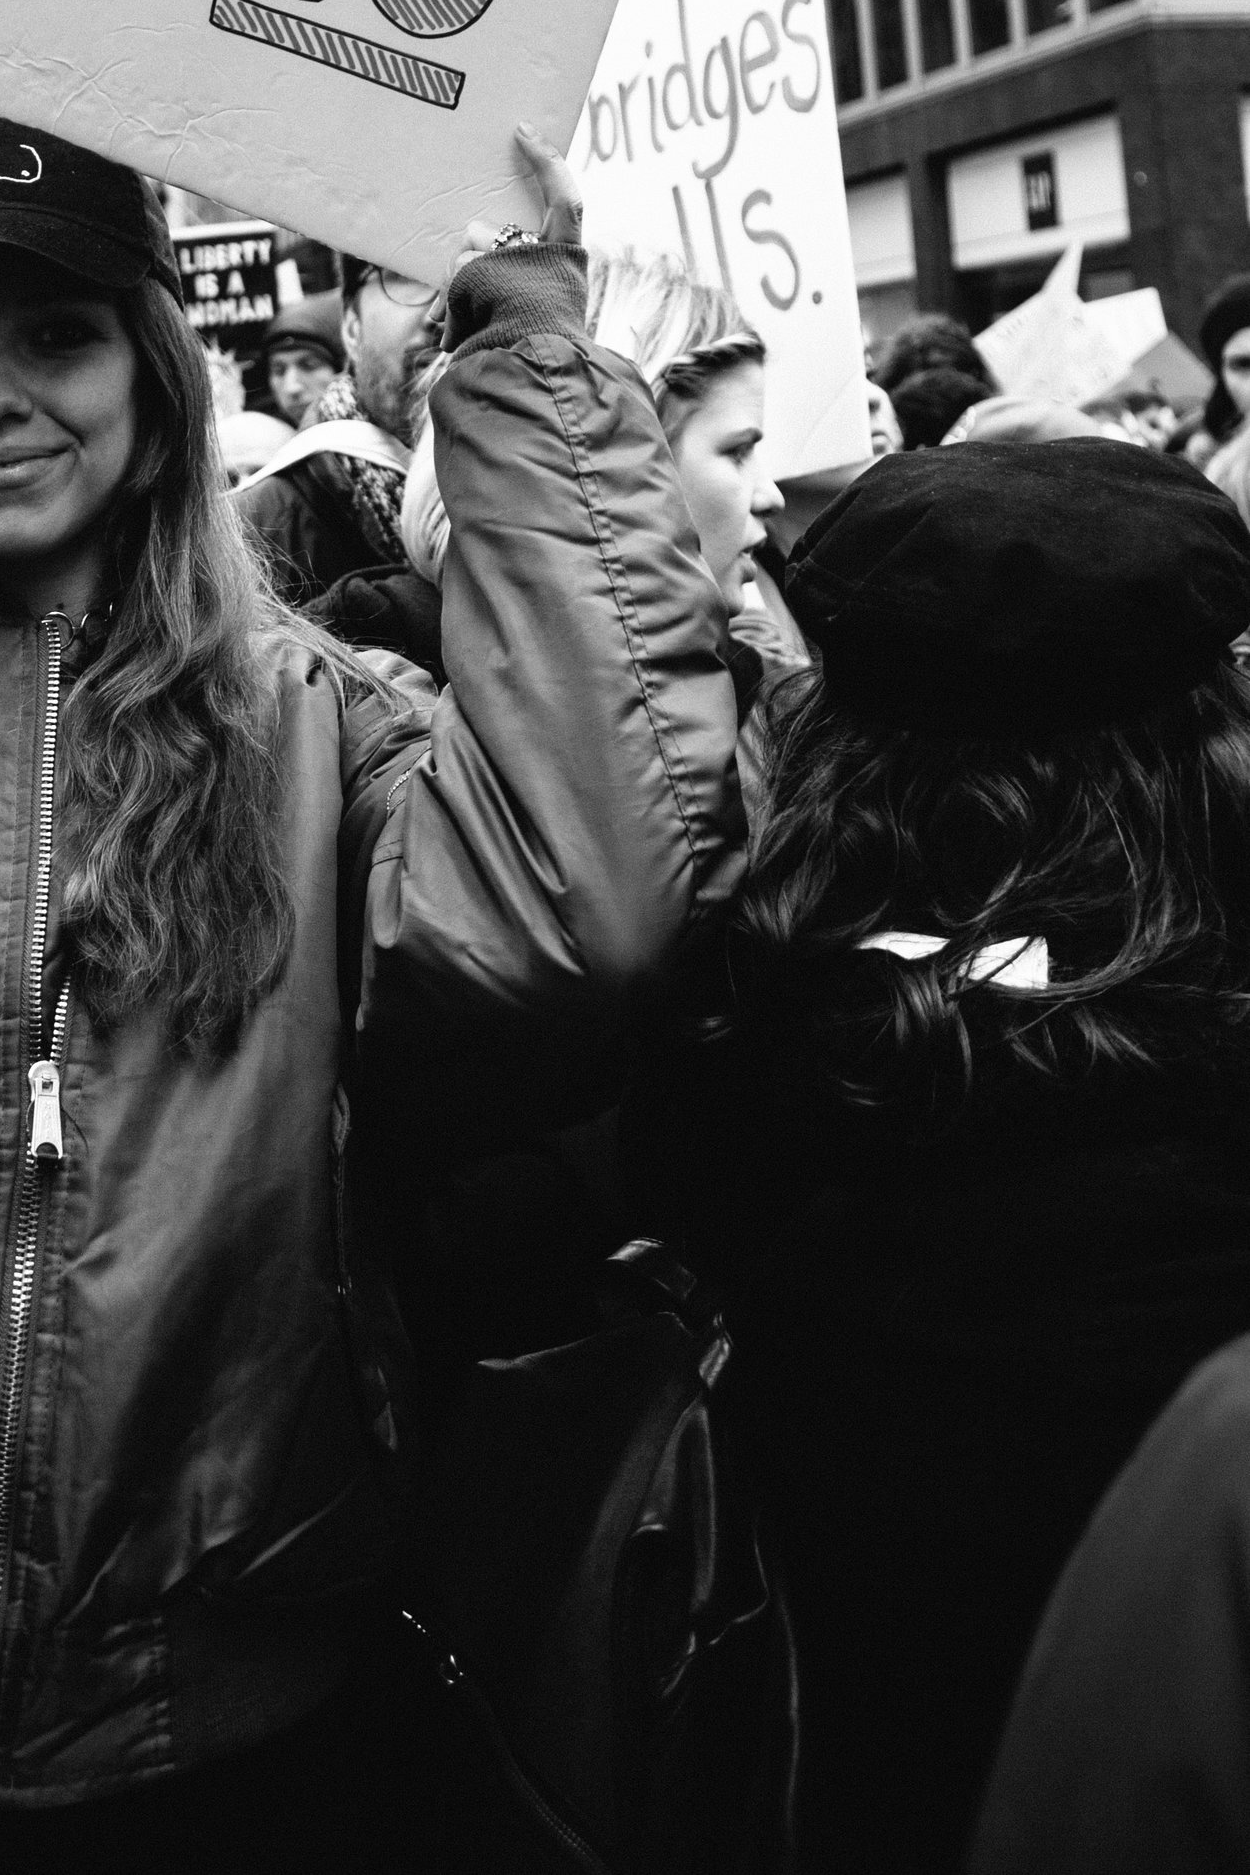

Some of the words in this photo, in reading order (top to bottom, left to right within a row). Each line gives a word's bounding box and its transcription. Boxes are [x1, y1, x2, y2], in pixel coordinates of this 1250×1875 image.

[179, 237, 272, 275] LIBERTY
[193, 271, 220, 300] IS
[226, 269, 246, 297] A
[184, 292, 275, 329] WOMAN
